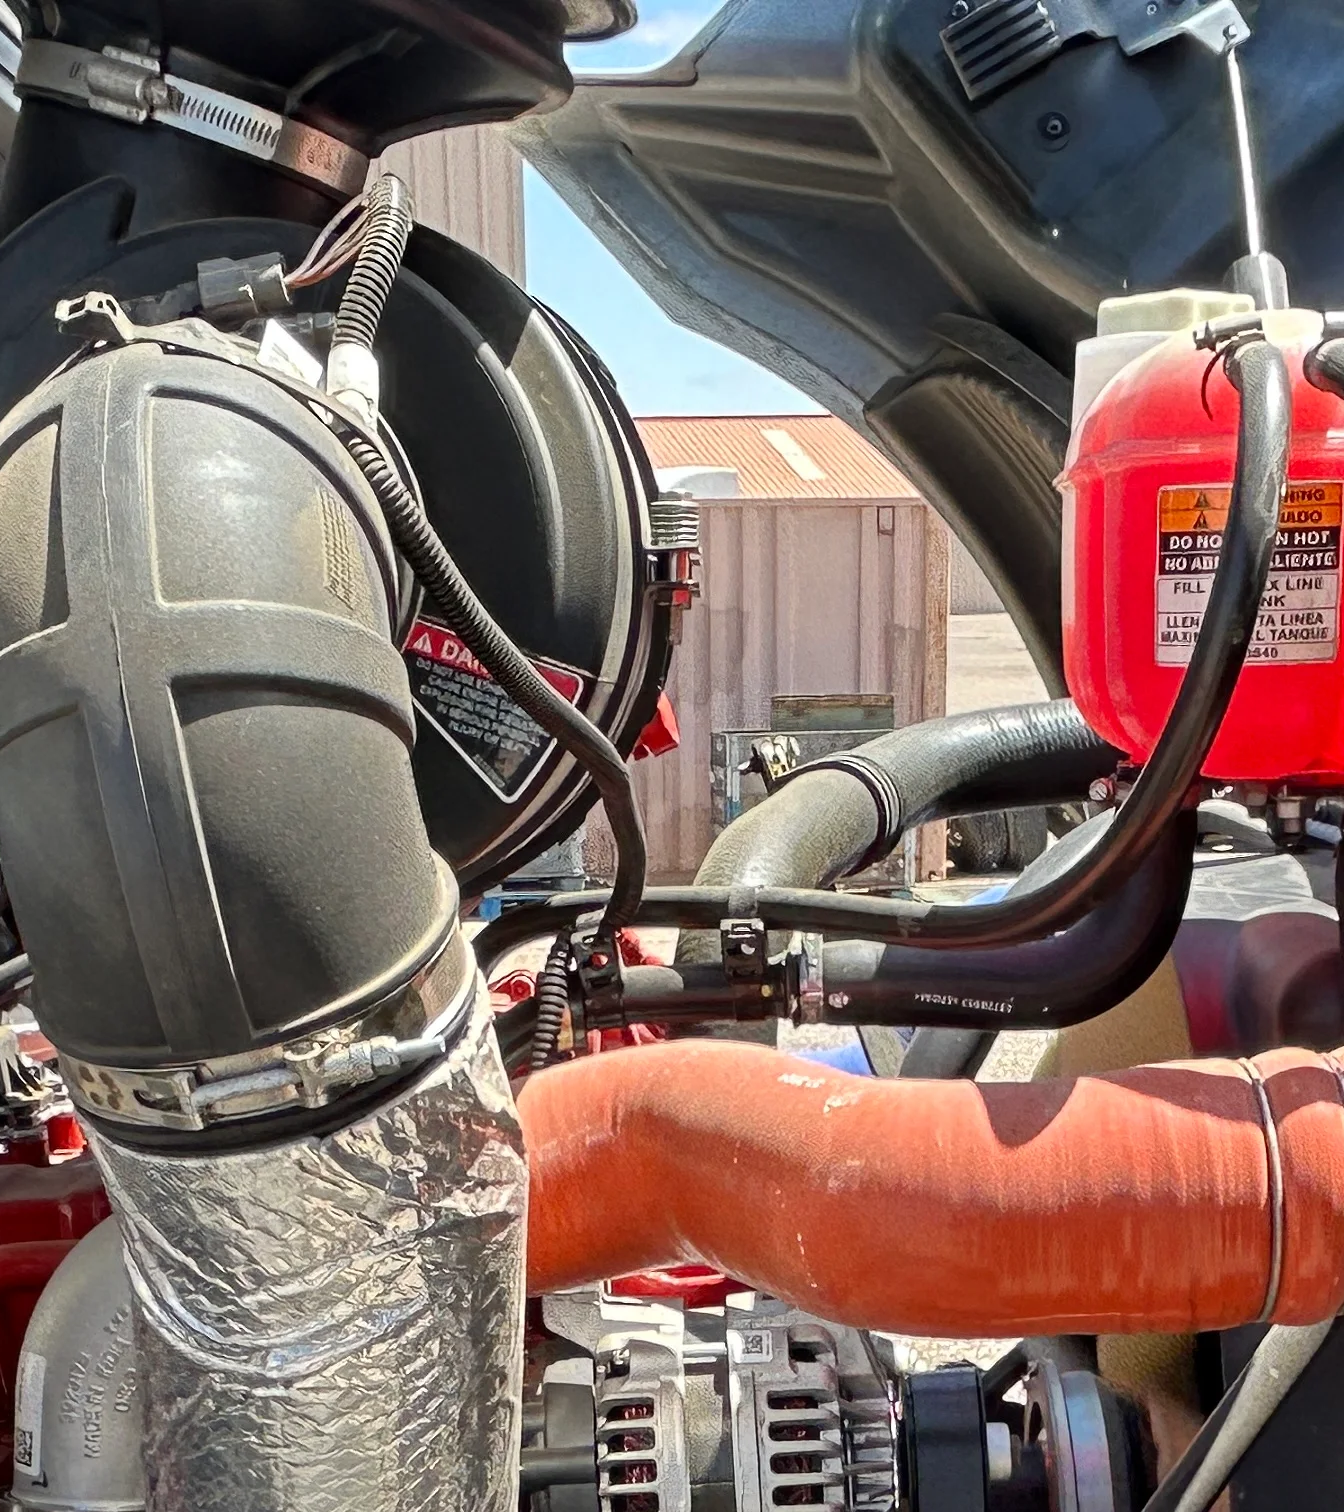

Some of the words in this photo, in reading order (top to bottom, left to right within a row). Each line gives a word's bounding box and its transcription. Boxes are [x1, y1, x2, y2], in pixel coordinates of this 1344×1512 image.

[1169, 535, 1193, 550] DO
[1196, 535, 1224, 549] NO
[1294, 530, 1331, 545] HOT
[1173, 580, 1206, 594] FILL
[1286, 576, 1324, 591] LINE
[1261, 594, 1287, 608] NK
[1166, 615, 1200, 629] LLEN
[1270, 627, 1329, 642] TANQUE
